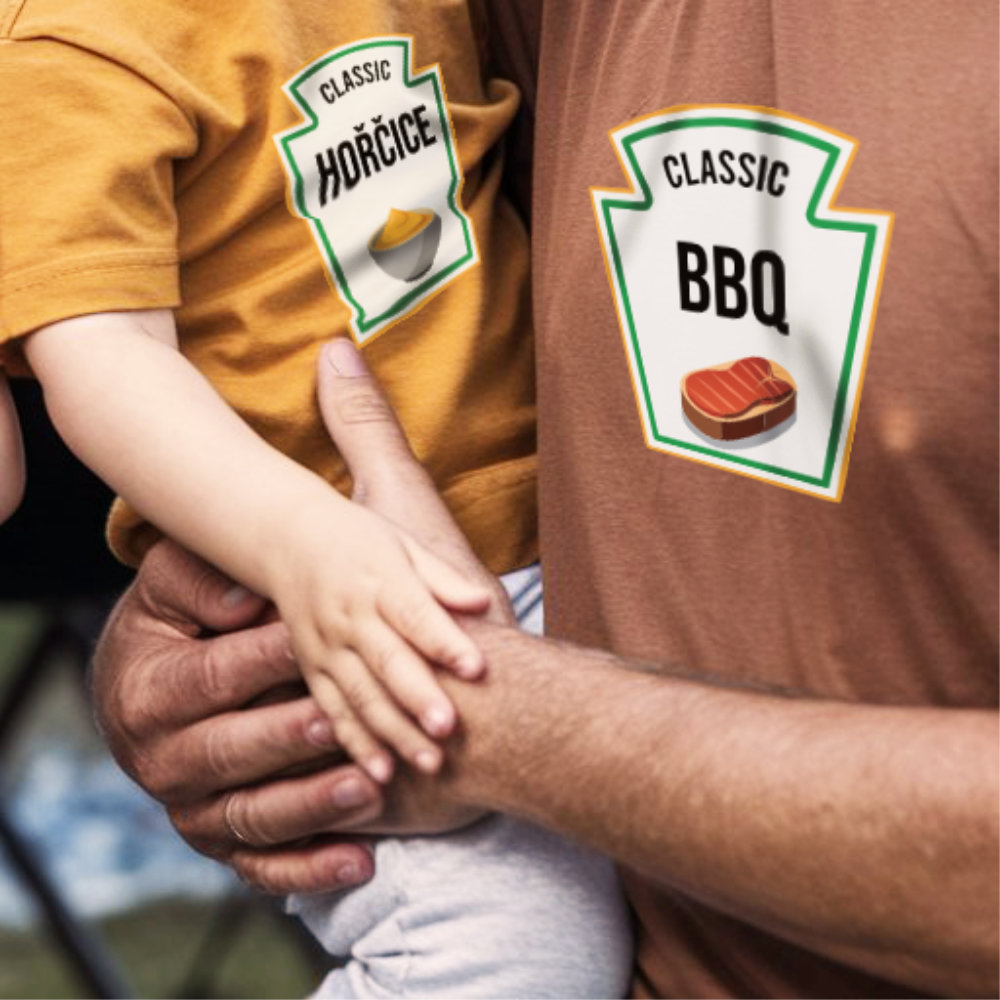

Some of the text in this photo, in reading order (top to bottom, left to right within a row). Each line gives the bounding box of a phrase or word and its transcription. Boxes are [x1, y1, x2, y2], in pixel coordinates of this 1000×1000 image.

[319, 59, 392, 104] CLASSIC
[315, 104, 438, 208] HOŘČICE
[662, 150, 790, 197] CLASSIC
[677, 240, 790, 336] BBQ
